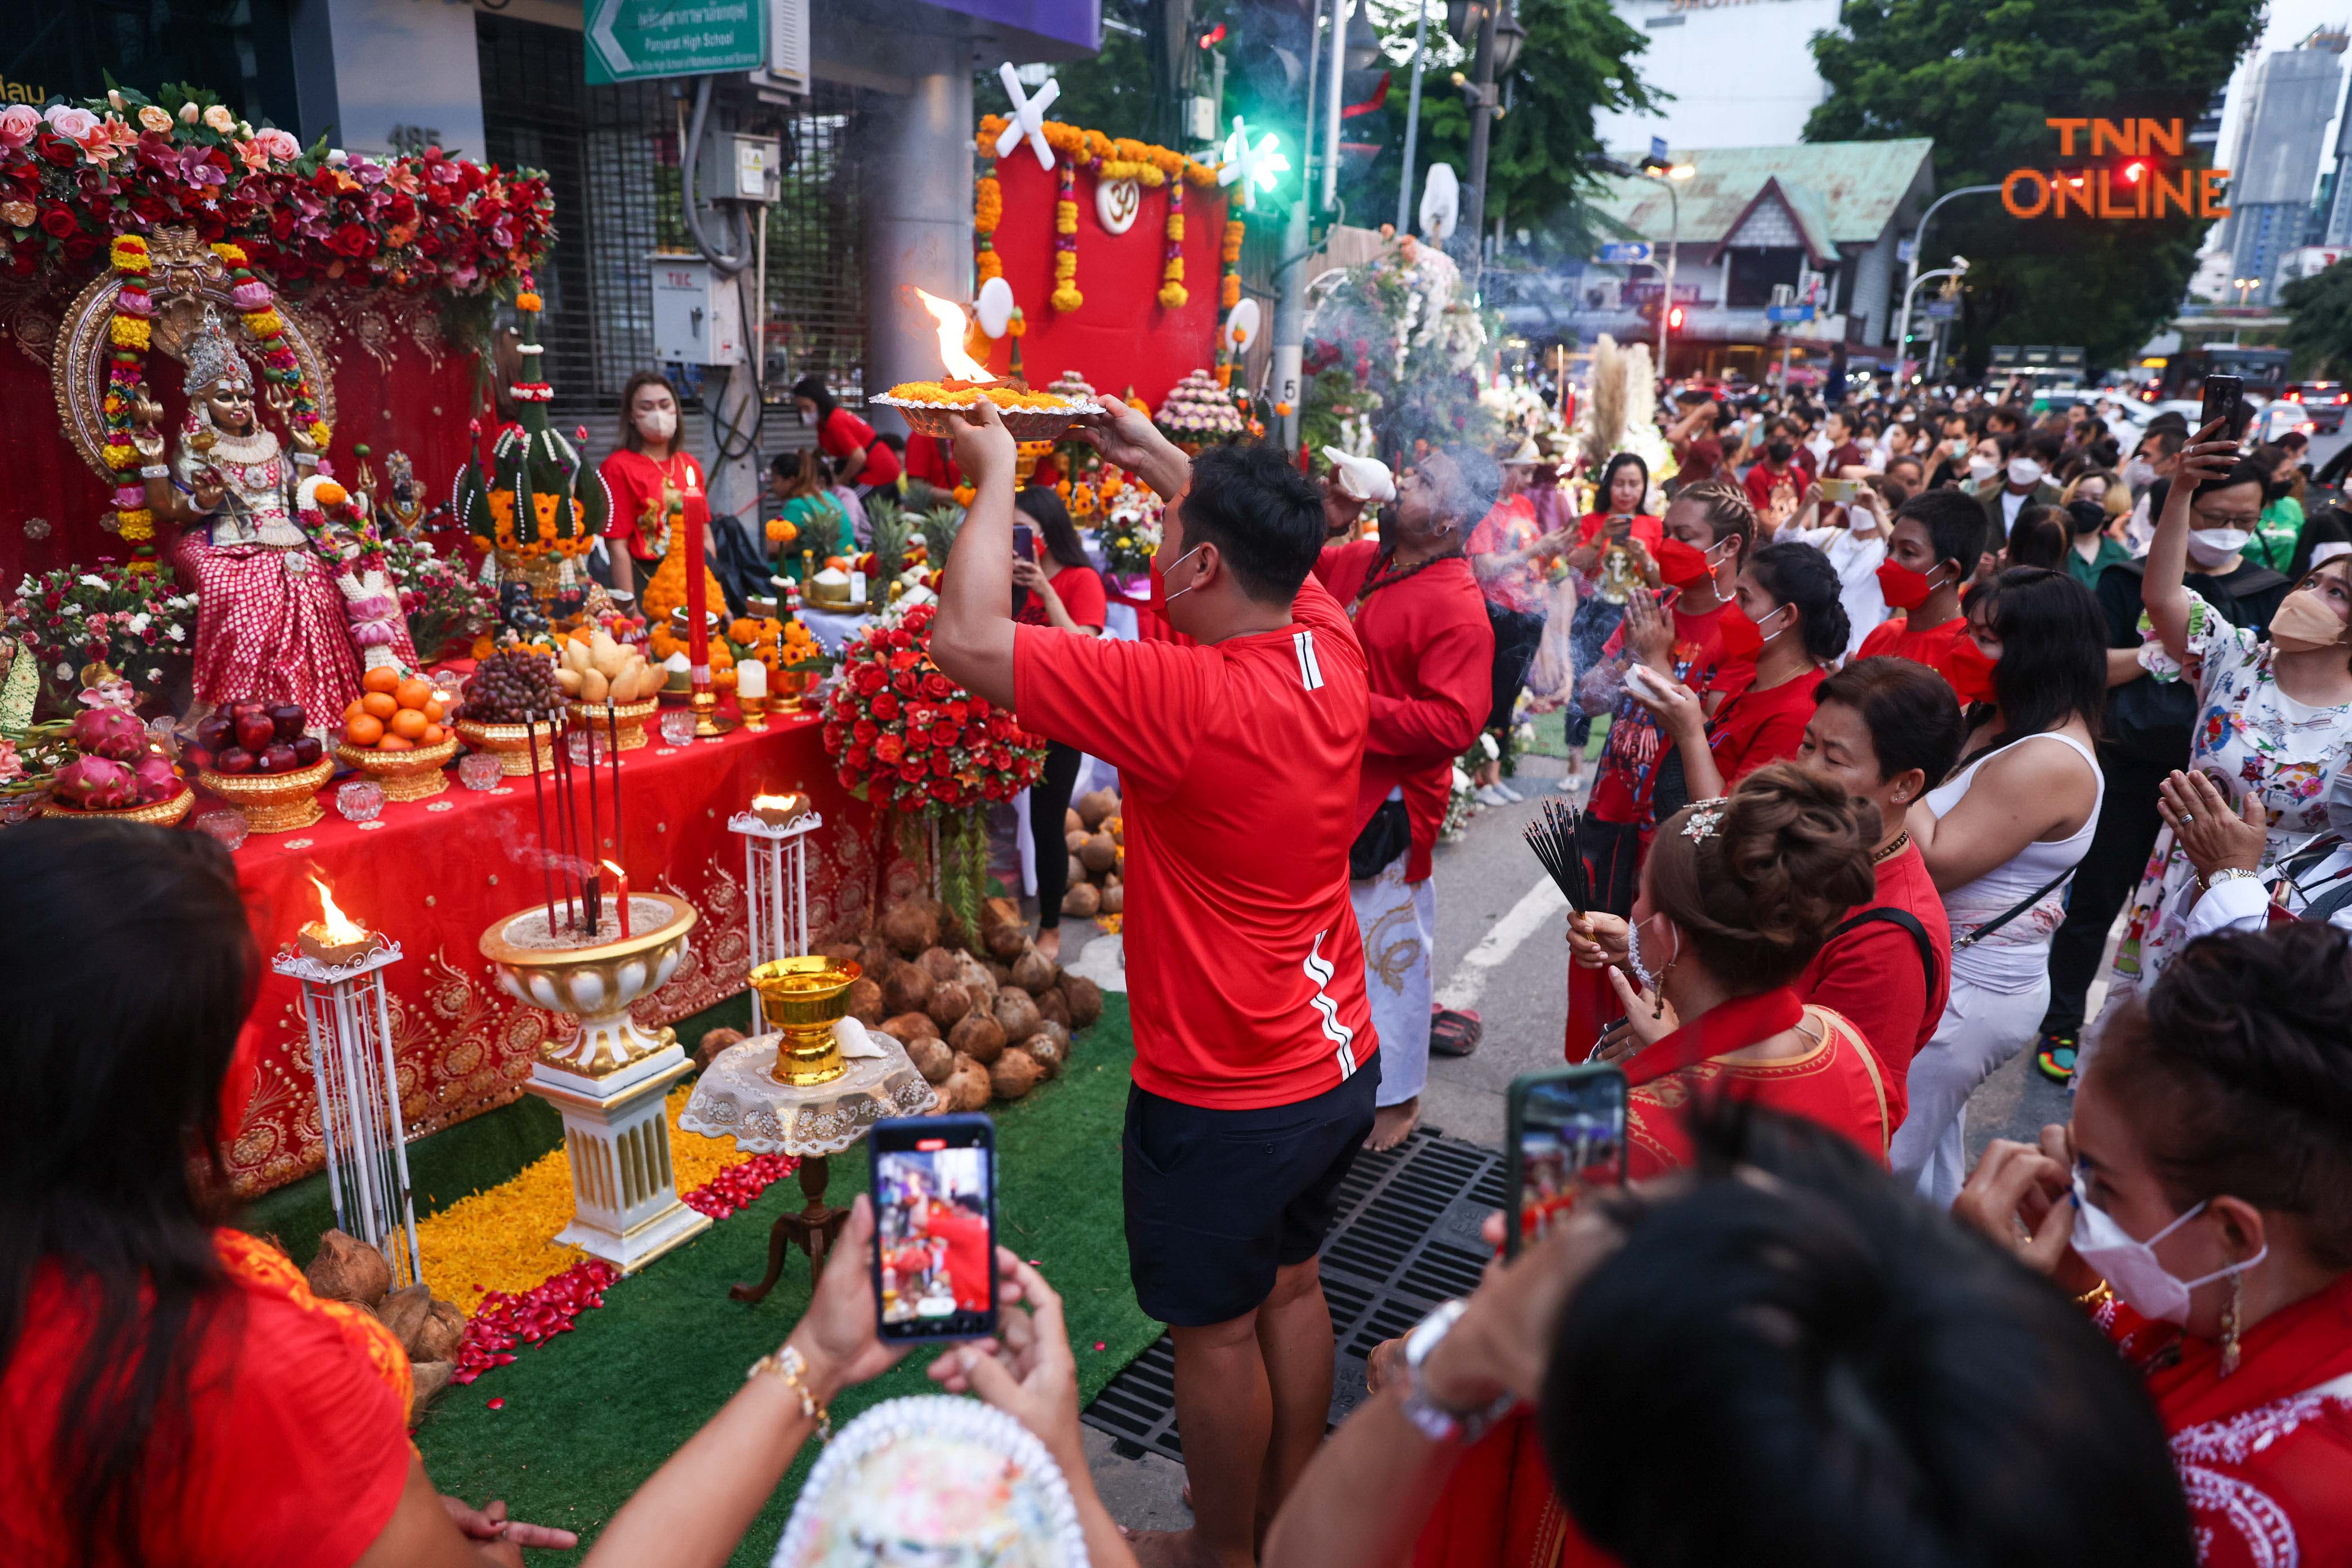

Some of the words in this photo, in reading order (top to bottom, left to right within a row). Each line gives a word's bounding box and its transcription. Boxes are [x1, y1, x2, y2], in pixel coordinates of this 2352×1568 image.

[682, 34, 702, 52] High
[703, 30, 734, 47] School
[1285, 380, 1295, 400] 5
